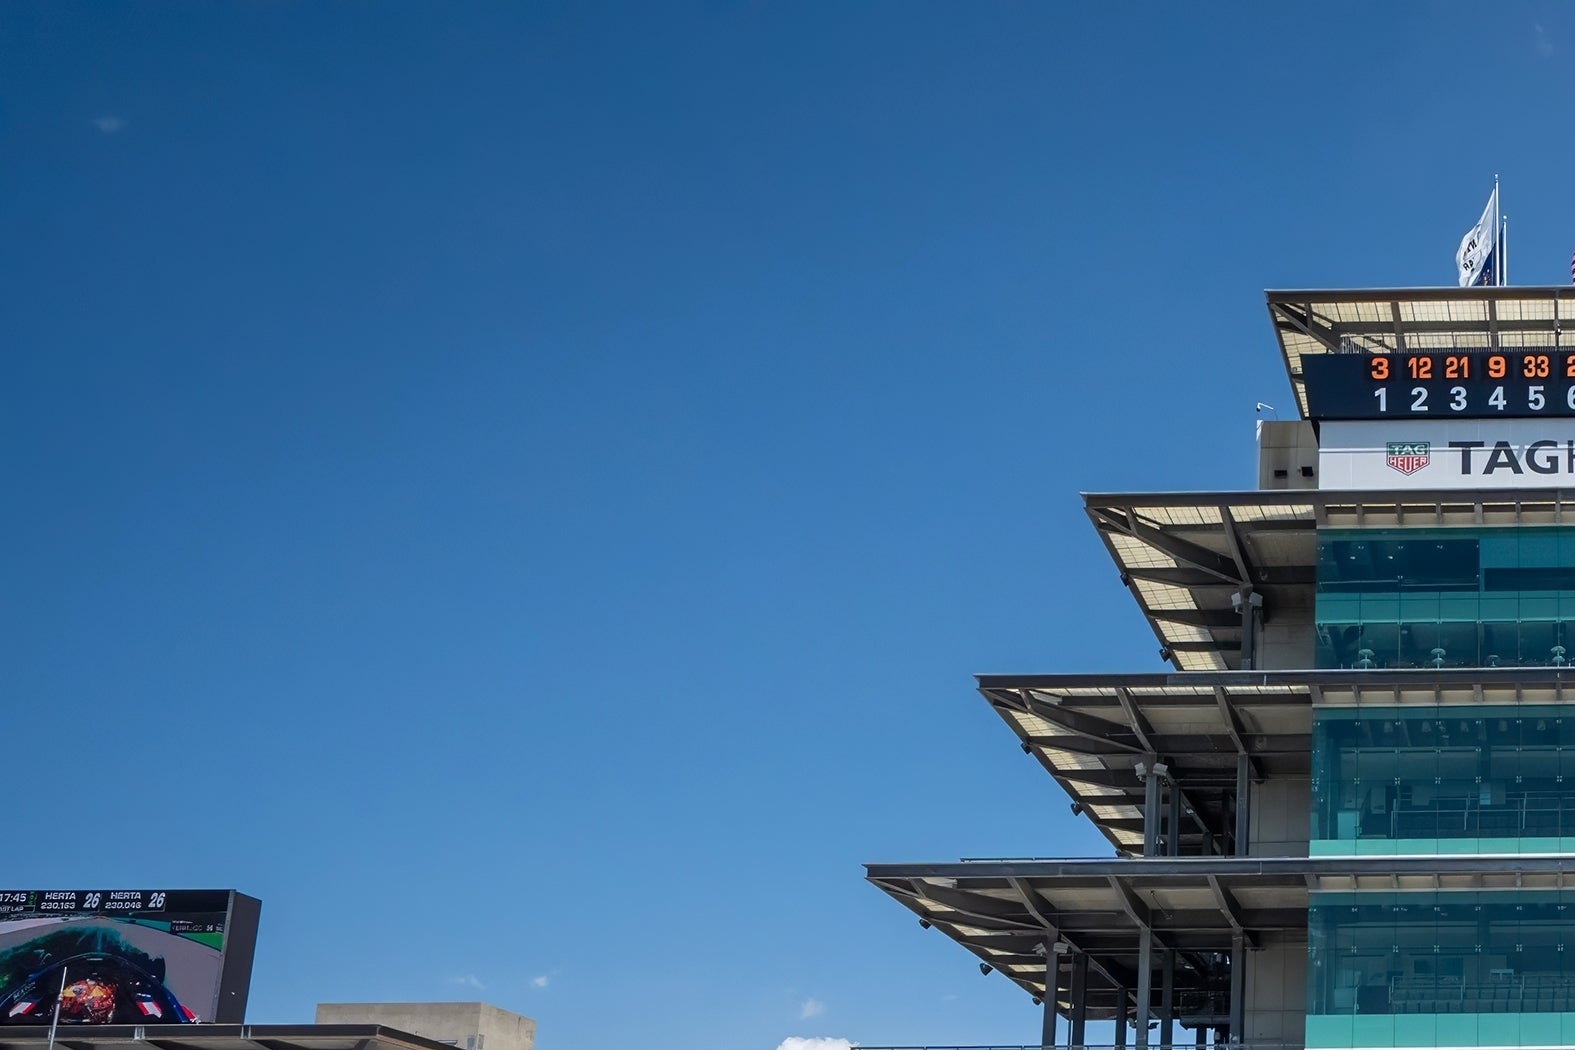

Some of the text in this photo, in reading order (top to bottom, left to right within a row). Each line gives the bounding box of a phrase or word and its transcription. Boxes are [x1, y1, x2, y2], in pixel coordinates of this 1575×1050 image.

[1371, 357, 1390, 380] 3
[1408, 355, 1432, 379] 12
[1445, 355, 1469, 379] 21
[1488, 355, 1507, 378] 9
[1523, 355, 1550, 378] 33
[1374, 387, 1387, 412] 1
[1410, 387, 1429, 411] 2
[1450, 386, 1468, 411] 3
[1488, 386, 1507, 410] 4
[1528, 385, 1546, 411] 5
[1391, 444, 1426, 455] TAG
[1388, 457, 1428, 474] HEUER
[45, 892, 76, 900] HERTA
[83, 892, 101, 909] 26
[110, 892, 142, 900] HERTA
[148, 892, 166, 908] 26
